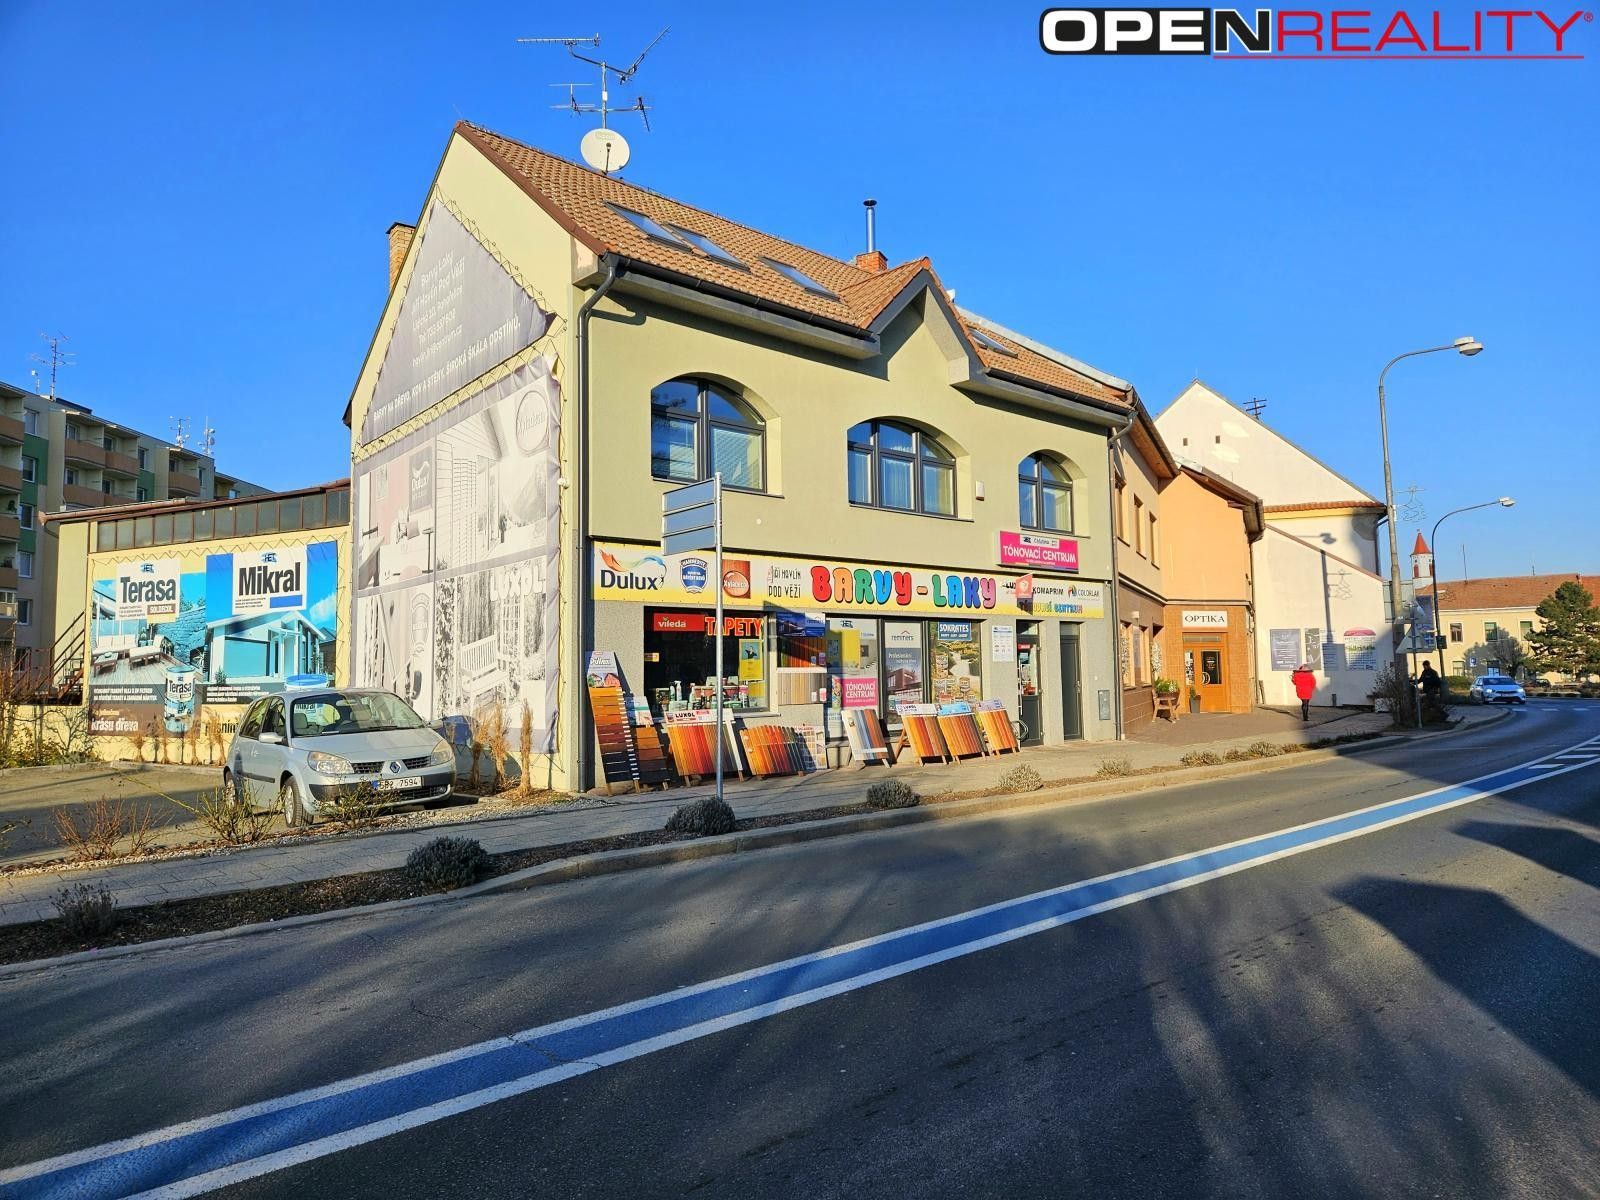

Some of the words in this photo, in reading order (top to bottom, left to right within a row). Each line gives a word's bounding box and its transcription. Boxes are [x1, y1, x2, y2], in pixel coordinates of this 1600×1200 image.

[468, 339, 488, 361] ŠKÁLA
[1003, 543, 1041, 560] TÓNOVACÍ
[1042, 550, 1077, 563] CENTRUM
[239, 562, 301, 596] Mikral
[600, 569, 658, 591] Dulux
[120, 576, 177, 604] Terasa
[768, 585, 782, 597] POD
[784, 583, 801, 598] VĚŽÍ
[810, 565, 912, 606] BARVY
[931, 574, 996, 609] LAKY
[658, 617, 686, 628] vileda
[1184, 615, 1225, 623] OPTIKA
[939, 624, 969, 633] SOKRATES
[169, 680, 192, 693] Terasa
[845, 690, 876, 698] CENTRUM
[674, 710, 695, 718] LUXOL
[116, 717, 139, 731] dřeva
[400, 777, 418, 787] 7594
